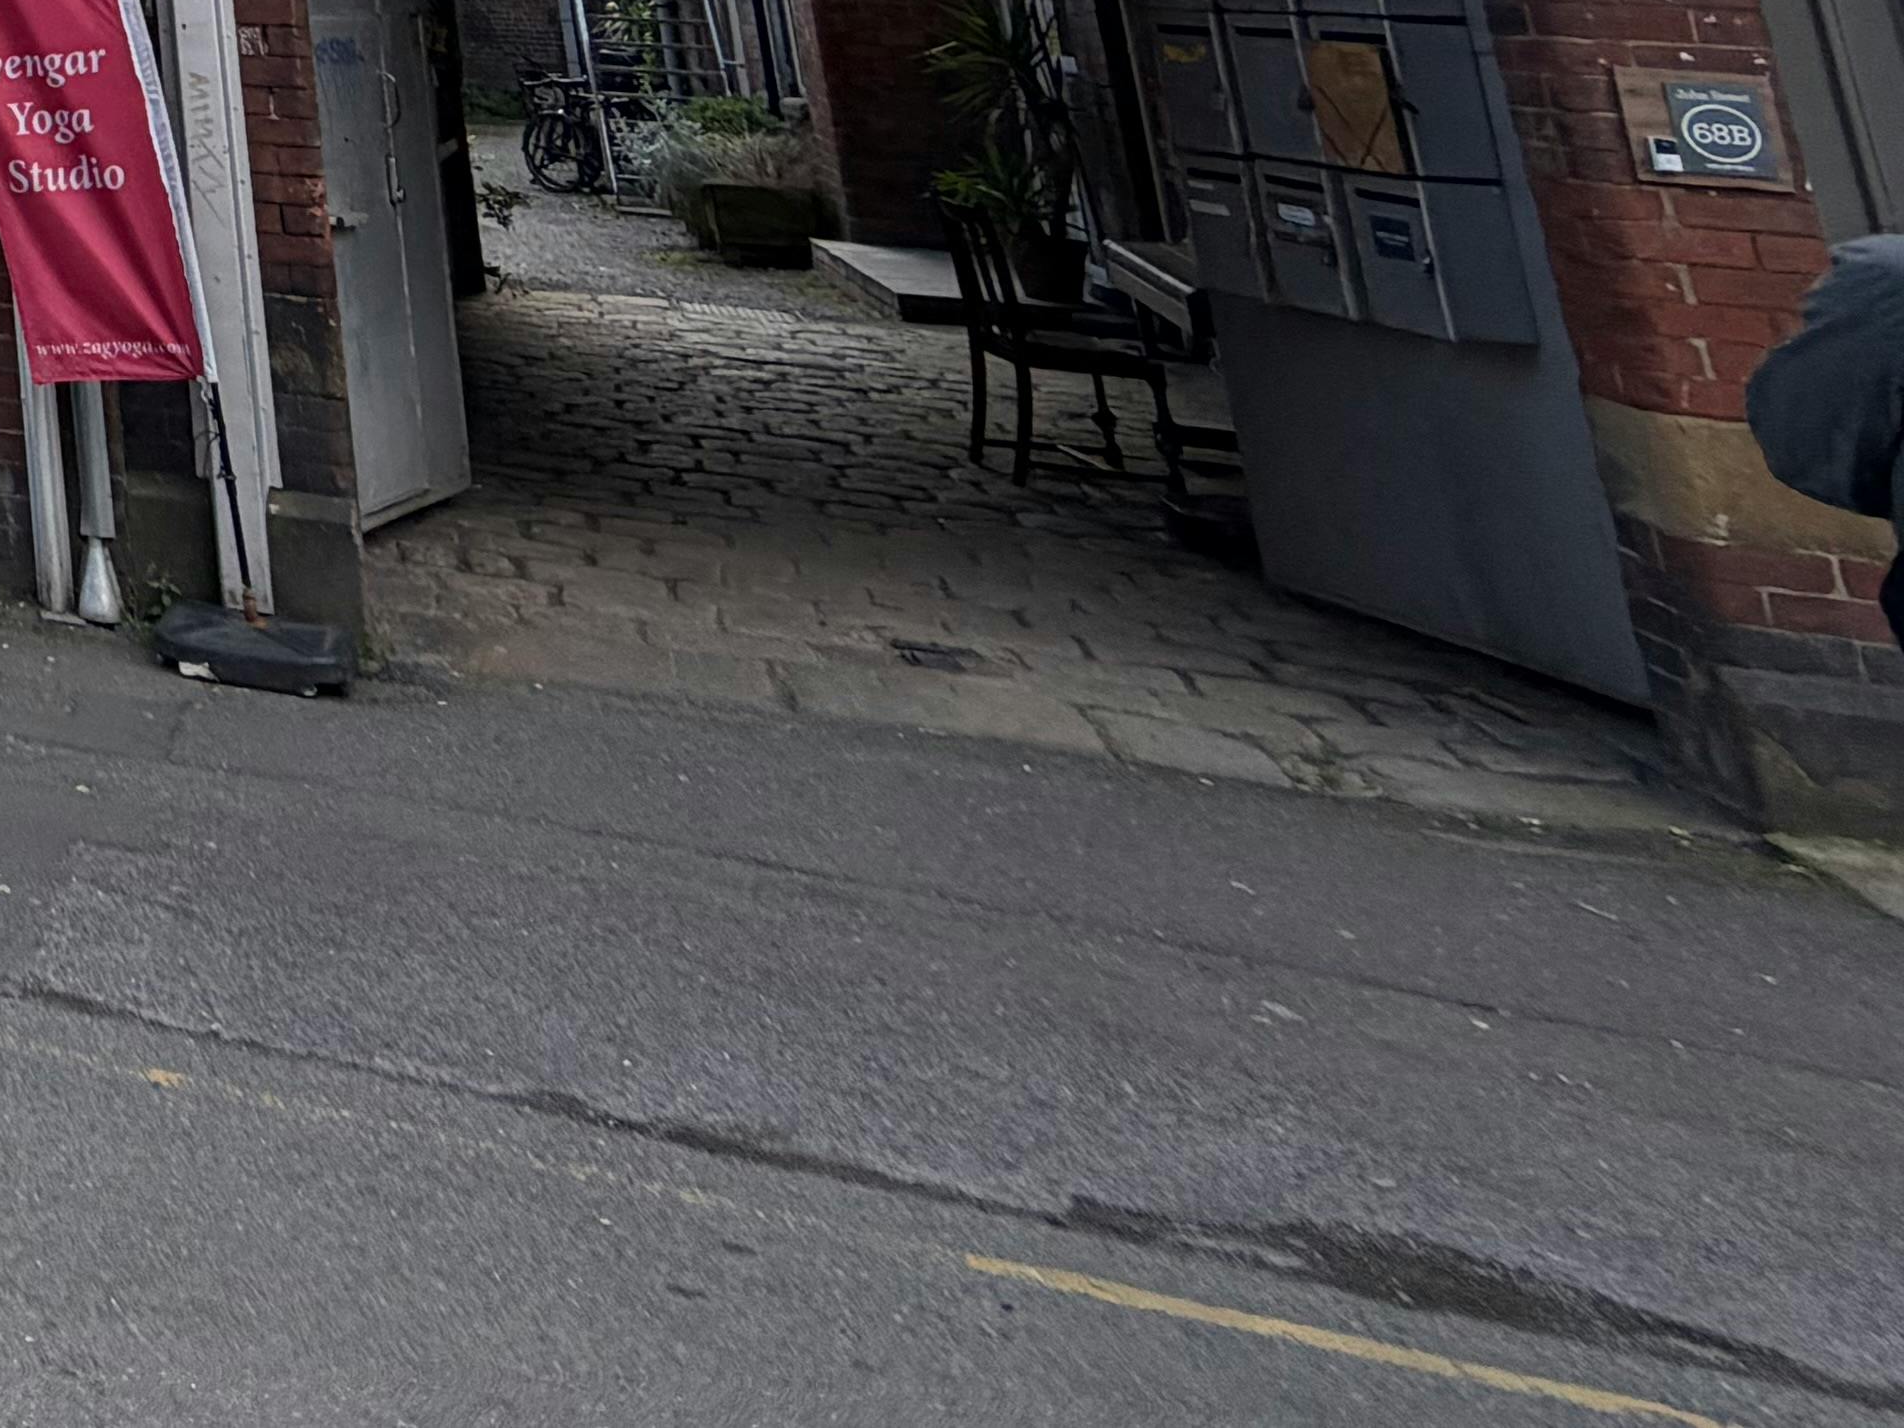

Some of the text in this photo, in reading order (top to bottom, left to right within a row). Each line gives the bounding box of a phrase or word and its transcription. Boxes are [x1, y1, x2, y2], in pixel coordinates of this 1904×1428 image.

[6, 101, 94, 144] Yoga
[1692, 121, 1752, 147] 68B
[8, 155, 125, 194] Studio
[36, 341, 191, 360] www.zagyoga.com
